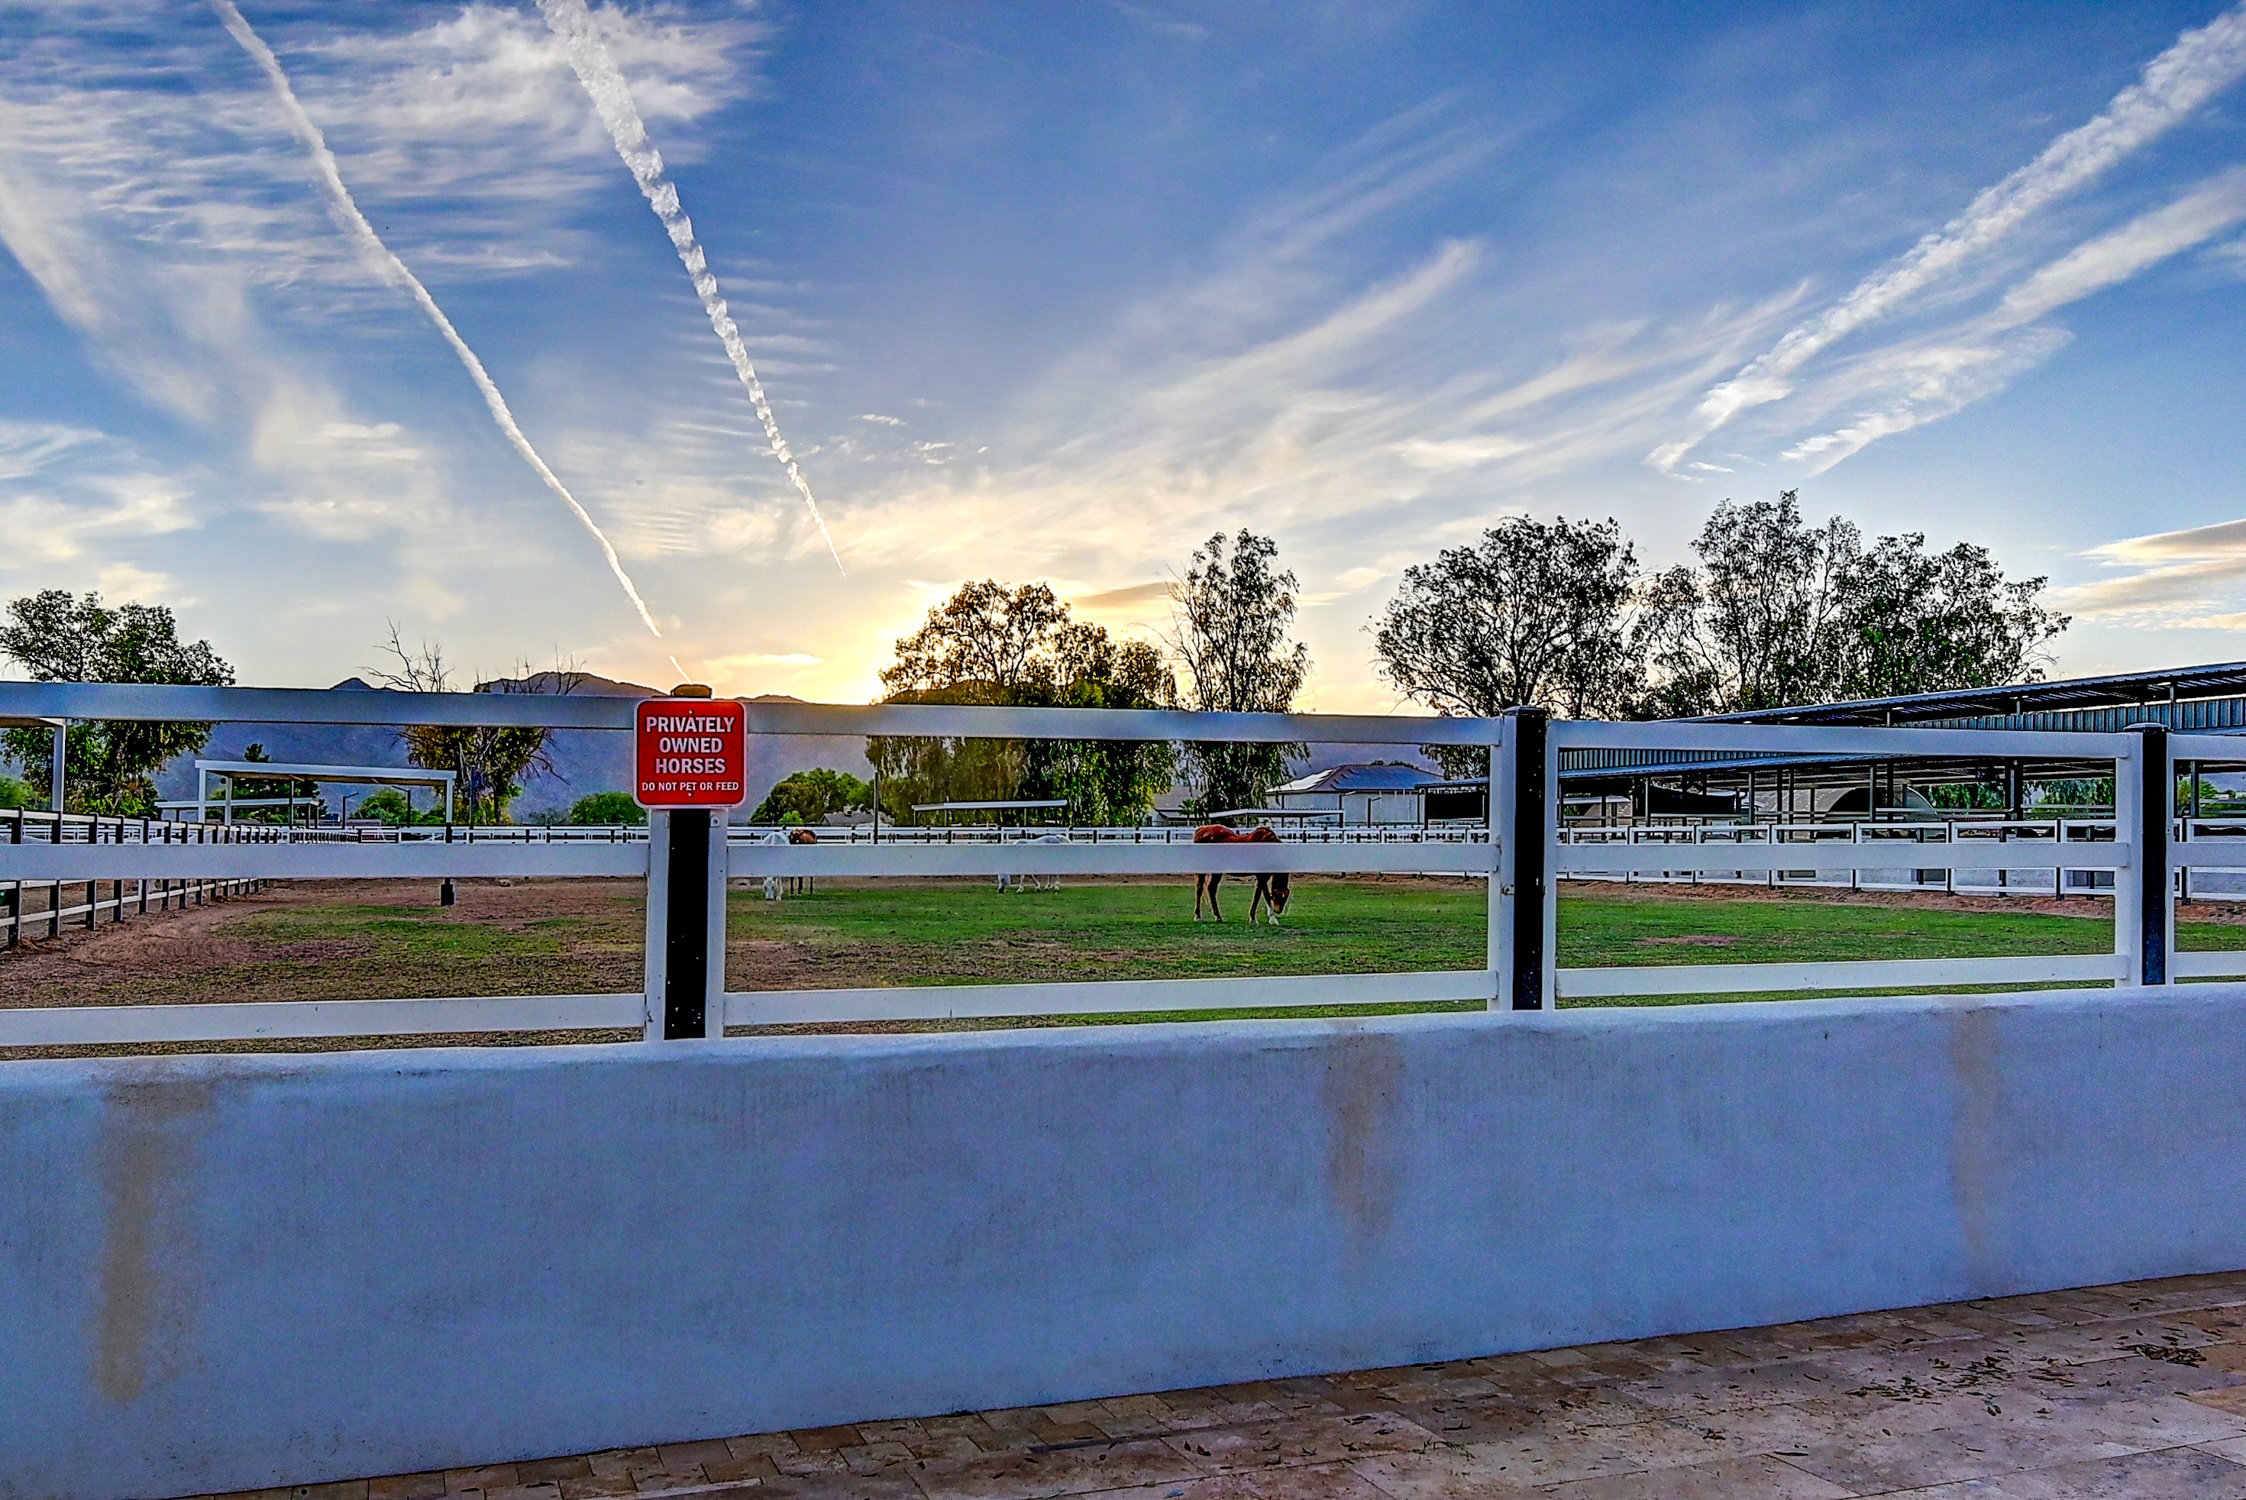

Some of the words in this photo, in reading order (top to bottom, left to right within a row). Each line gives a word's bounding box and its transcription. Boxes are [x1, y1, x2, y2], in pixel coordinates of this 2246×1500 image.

[646, 716, 735, 732] PRIVATELY
[659, 737, 723, 753] OWNED
[655, 758, 726, 774] HORSES
[642, 782, 655, 791] DO
[659, 782, 677, 791] NOT
[680, 782, 697, 791] PET
[700, 782, 713, 791] OR
[716, 782, 739, 791] FEED
